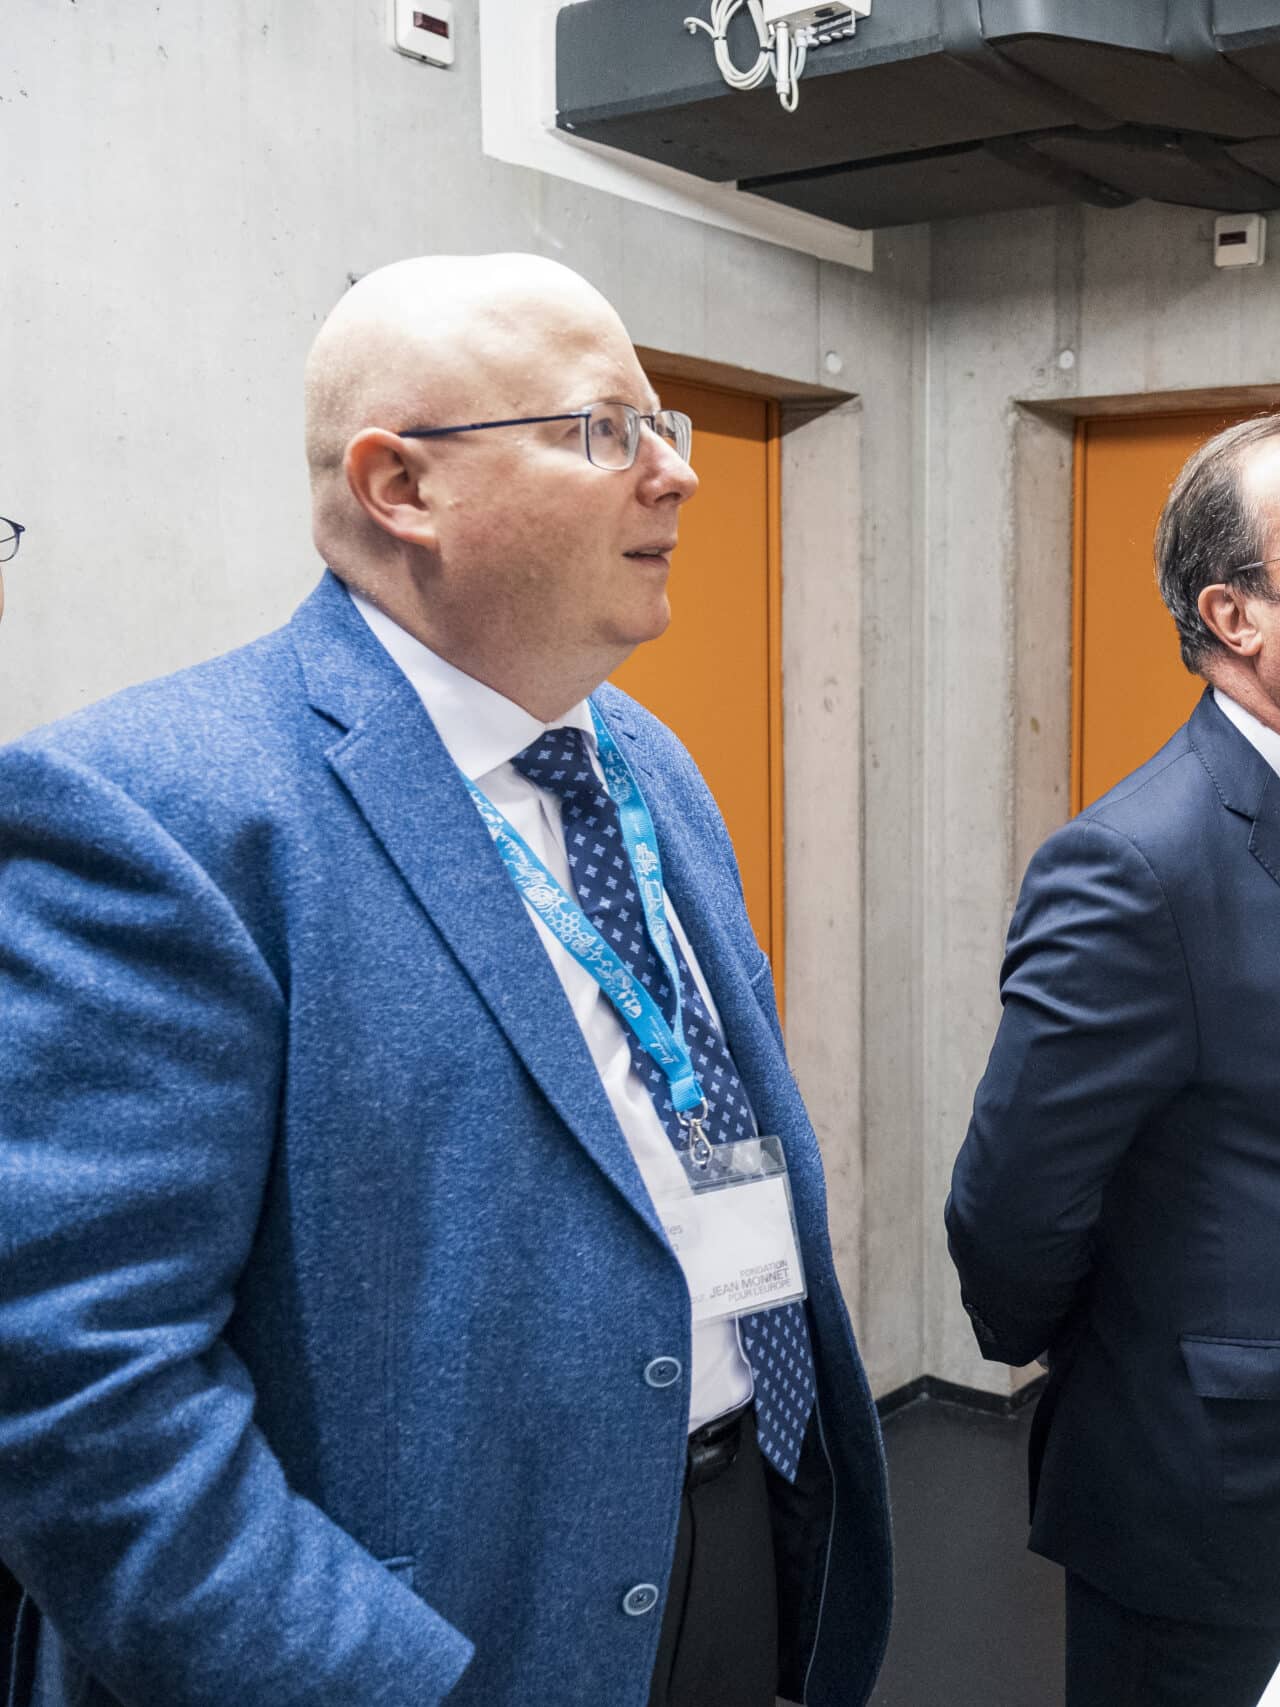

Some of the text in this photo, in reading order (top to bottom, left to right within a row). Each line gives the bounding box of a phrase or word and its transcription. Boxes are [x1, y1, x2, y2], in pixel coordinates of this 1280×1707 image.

[740, 1260, 788, 1277] FONDATION
[710, 1281, 739, 1299] JEAN
[741, 1268, 789, 1289] MONNET
[728, 1288, 753, 1302] POUR
